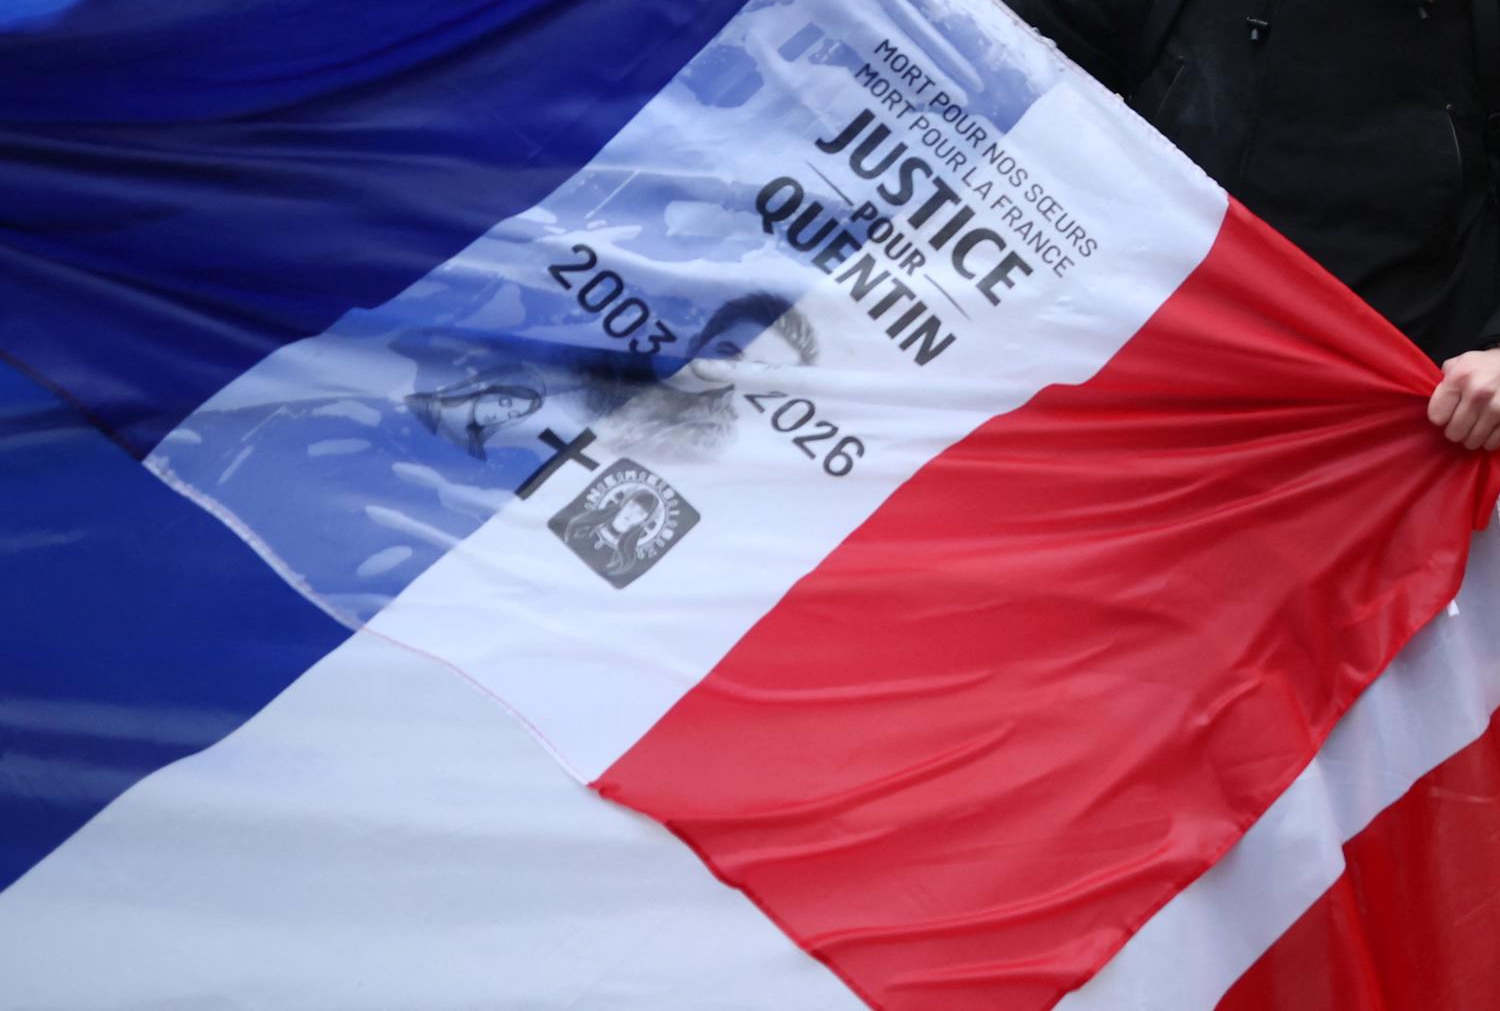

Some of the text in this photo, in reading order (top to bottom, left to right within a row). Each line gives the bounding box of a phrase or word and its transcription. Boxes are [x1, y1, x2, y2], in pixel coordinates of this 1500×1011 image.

[815, 108, 1034, 307] JUSTICE
[850, 201, 926, 276] POUR
[855, 62, 1075, 278] MORT POUR LA FRANCE
[873, 39, 1098, 258] MORT POUR NOS SŒURS
[547, 243, 677, 360] 2003
[754, 176, 956, 367] QUENTIN
[744, 389, 866, 478] 2026
